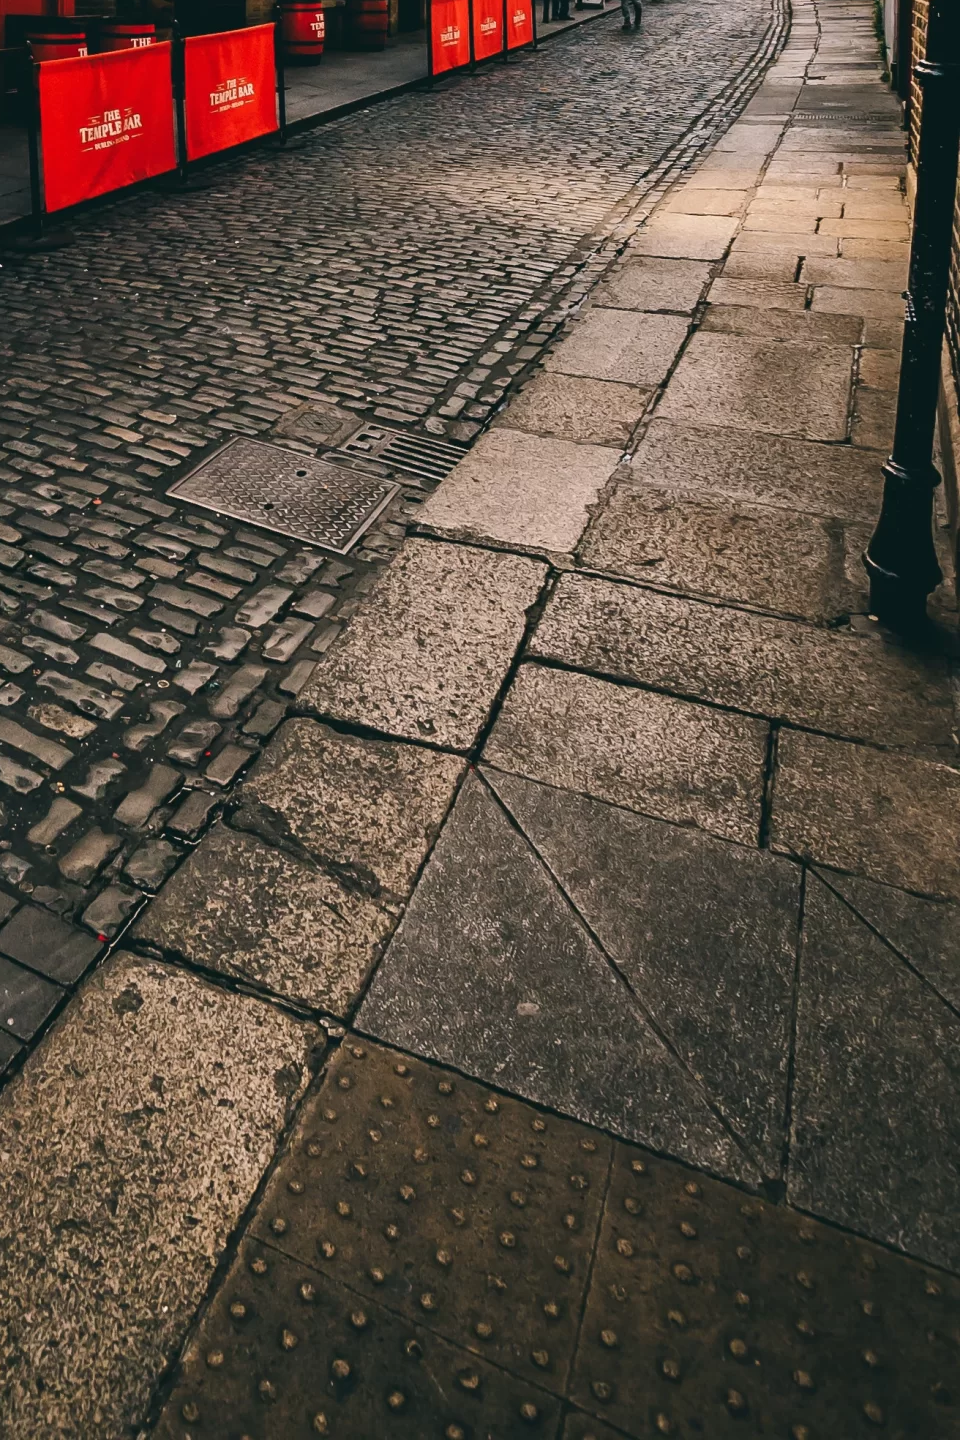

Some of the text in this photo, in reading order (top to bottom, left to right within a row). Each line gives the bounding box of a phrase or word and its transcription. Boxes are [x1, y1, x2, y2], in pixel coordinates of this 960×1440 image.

[130, 37, 152, 49] THE
[209, 88, 238, 106] TEMPLE
[238, 83, 255, 98] BAR
[103, 109, 122, 123] THE
[79, 120, 123, 144] TEMPLE
